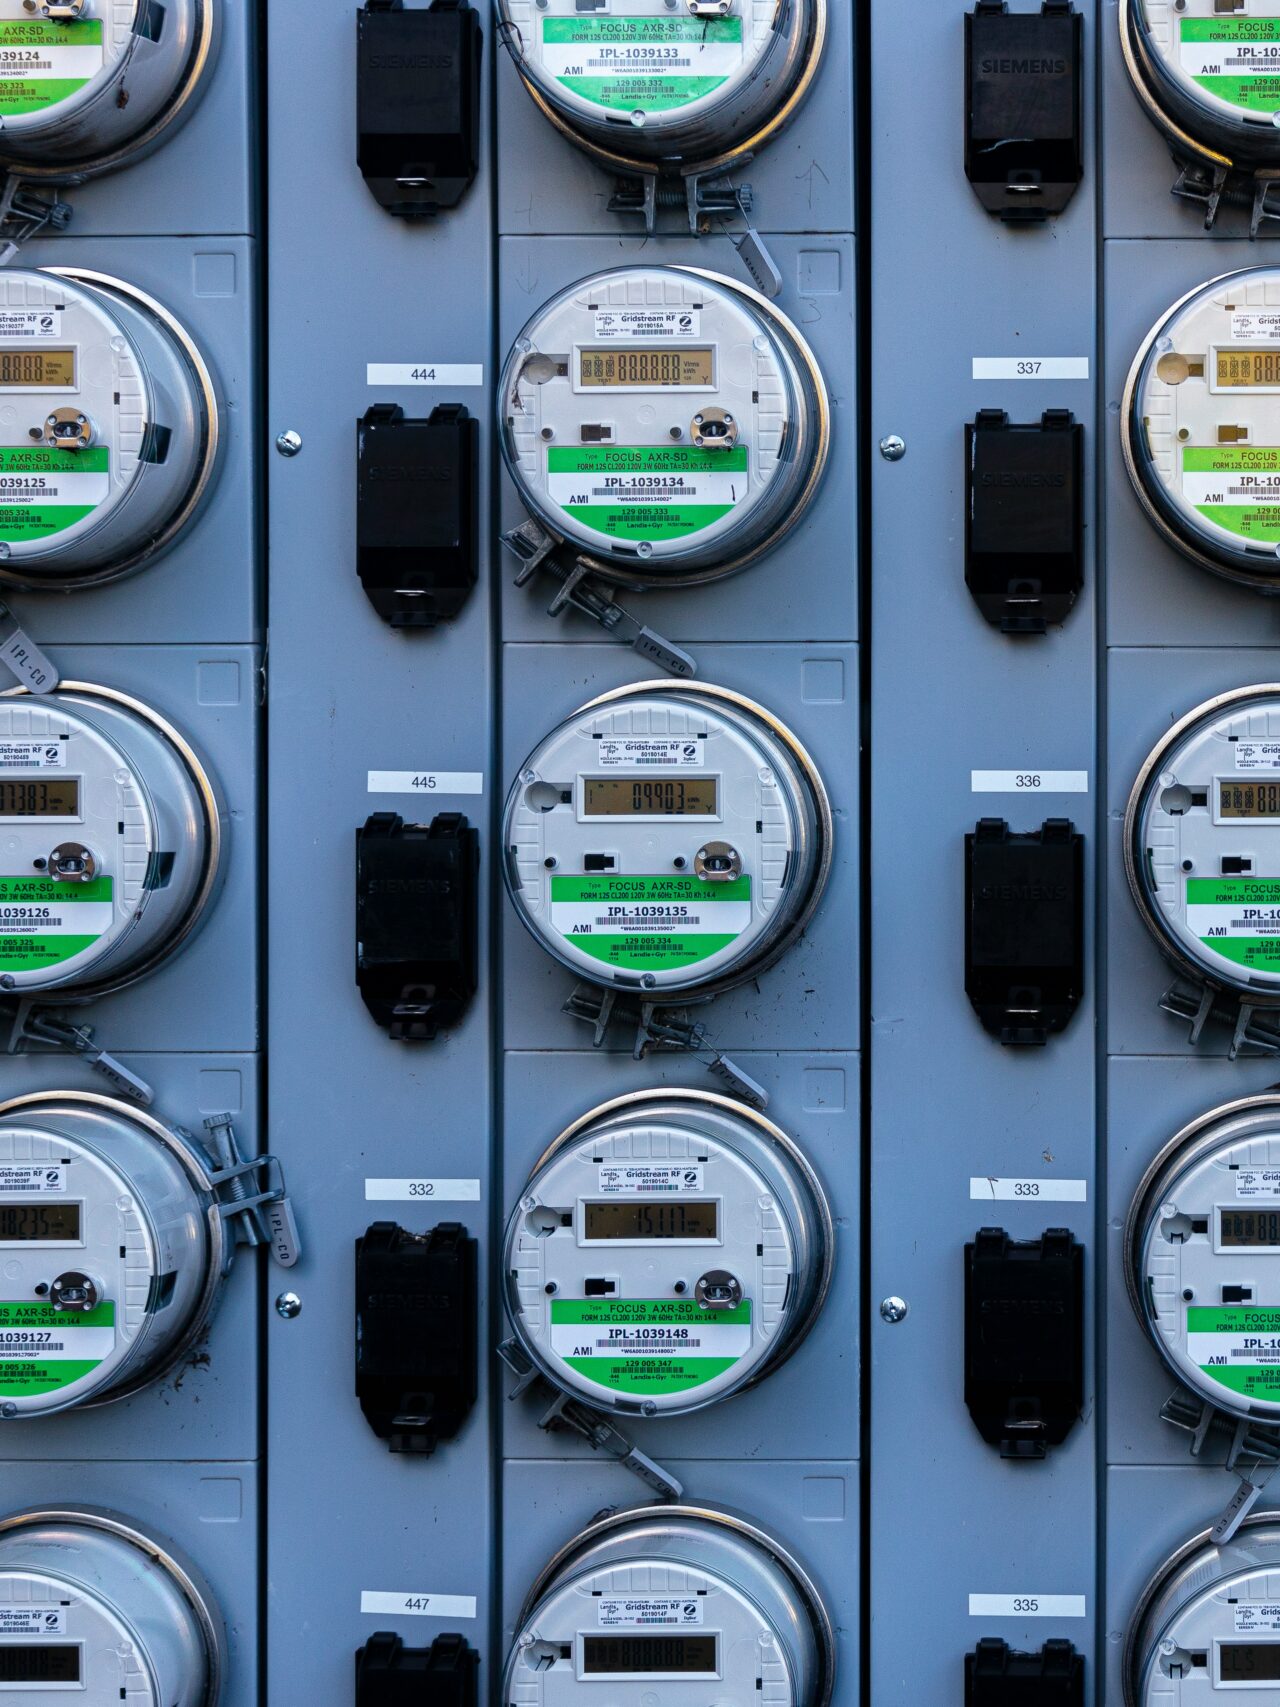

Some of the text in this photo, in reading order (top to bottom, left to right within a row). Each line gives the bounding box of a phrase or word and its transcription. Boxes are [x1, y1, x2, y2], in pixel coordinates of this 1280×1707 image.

[3, 26, 44, 36] AXR-SD
[600, 23, 683, 32] FOCUS AXR-SD
[1238, 23, 1275, 32] FOCUS
[599, 48, 679, 58] IPL-1039133
[369, 53, 453, 70] SIEMENS
[981, 58, 1066, 74] SIEMENS
[564, 66, 584, 75] AMI
[1201, 65, 1221, 74] AMI
[1018, 362, 1042, 374] 337
[412, 368, 436, 380] 444
[10, 453, 50, 463] AXR-SD
[606, 452, 688, 462] FOCUS AXR-SD
[1241, 452, 1278, 461] FOCUS
[604, 476, 684, 487] IPL-1039134
[569, 495, 589, 504] AMI
[1204, 494, 1224, 503] AMI
[10, 644, 46, 685] IPL-CO
[412, 776, 436, 788] 445
[1016, 774, 1040, 788] 336
[13, 883, 54, 892] AXR-SD
[609, 881, 692, 891] FOCUS AXR-SD
[1244, 884, 1280, 893] FOCUS
[608, 906, 688, 916] IPL-1039135
[572, 924, 592, 934] AMI
[1207, 927, 1227, 936] AMI
[410, 1184, 434, 1196] 332
[1014, 1184, 1040, 1196] 333
[270, 1213, 289, 1260] IPL-CO
[15, 1308, 56, 1317] AXR-SD
[610, 1304, 693, 1313] FOCUS AXR-SD
[1245, 1314, 1280, 1323] FOCUS
[608, 1329, 689, 1339] IPL-1039148
[573, 1347, 593, 1356] AMI
[1208, 1356, 1228, 1366] AMI
[404, 1598, 430, 1610] 447
[1014, 1598, 1038, 1612] 335
